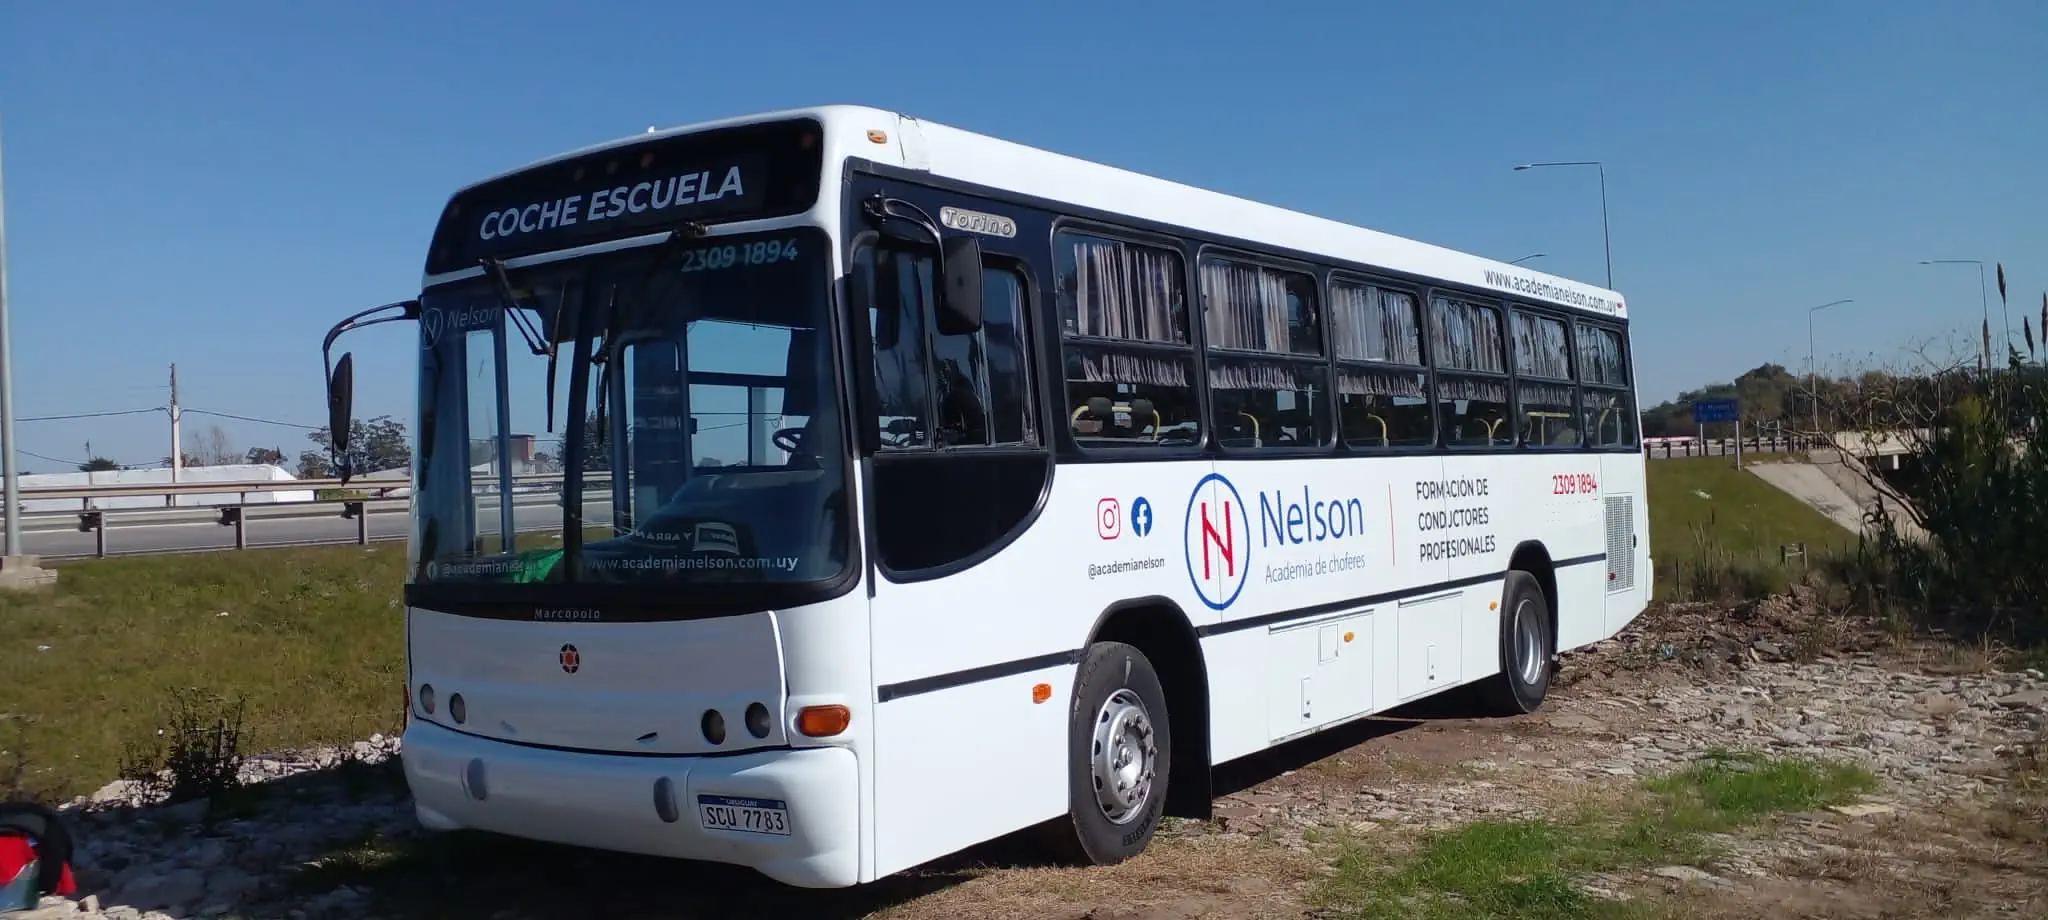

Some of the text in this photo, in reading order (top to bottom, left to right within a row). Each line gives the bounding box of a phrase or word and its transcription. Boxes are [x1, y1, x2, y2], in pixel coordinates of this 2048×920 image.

[480, 166, 743, 241] COCHE ESCUELA
[946, 207, 1012, 235] Torino
[681, 239, 798, 273] 2309 1894
[1484, 268, 1617, 314] www.academianelson.com.uy
[447, 304, 499, 329] Nelson
[1416, 474, 1489, 500] FORMACIÓN DE
[1552, 472, 1598, 495] 2309 1894
[1259, 485, 1364, 548] Nelson
[1418, 506, 1489, 531] CONDUCTORES
[1420, 534, 1496, 562] PROFESIONALES
[588, 554, 799, 572] www.academianelson.com.uy
[1088, 556, 1165, 580] @academianelson
[1265, 551, 1366, 585] Academia de choferes
[534, 607, 601, 619] Marcopolo
[706, 806, 785, 831] SCU 7783
